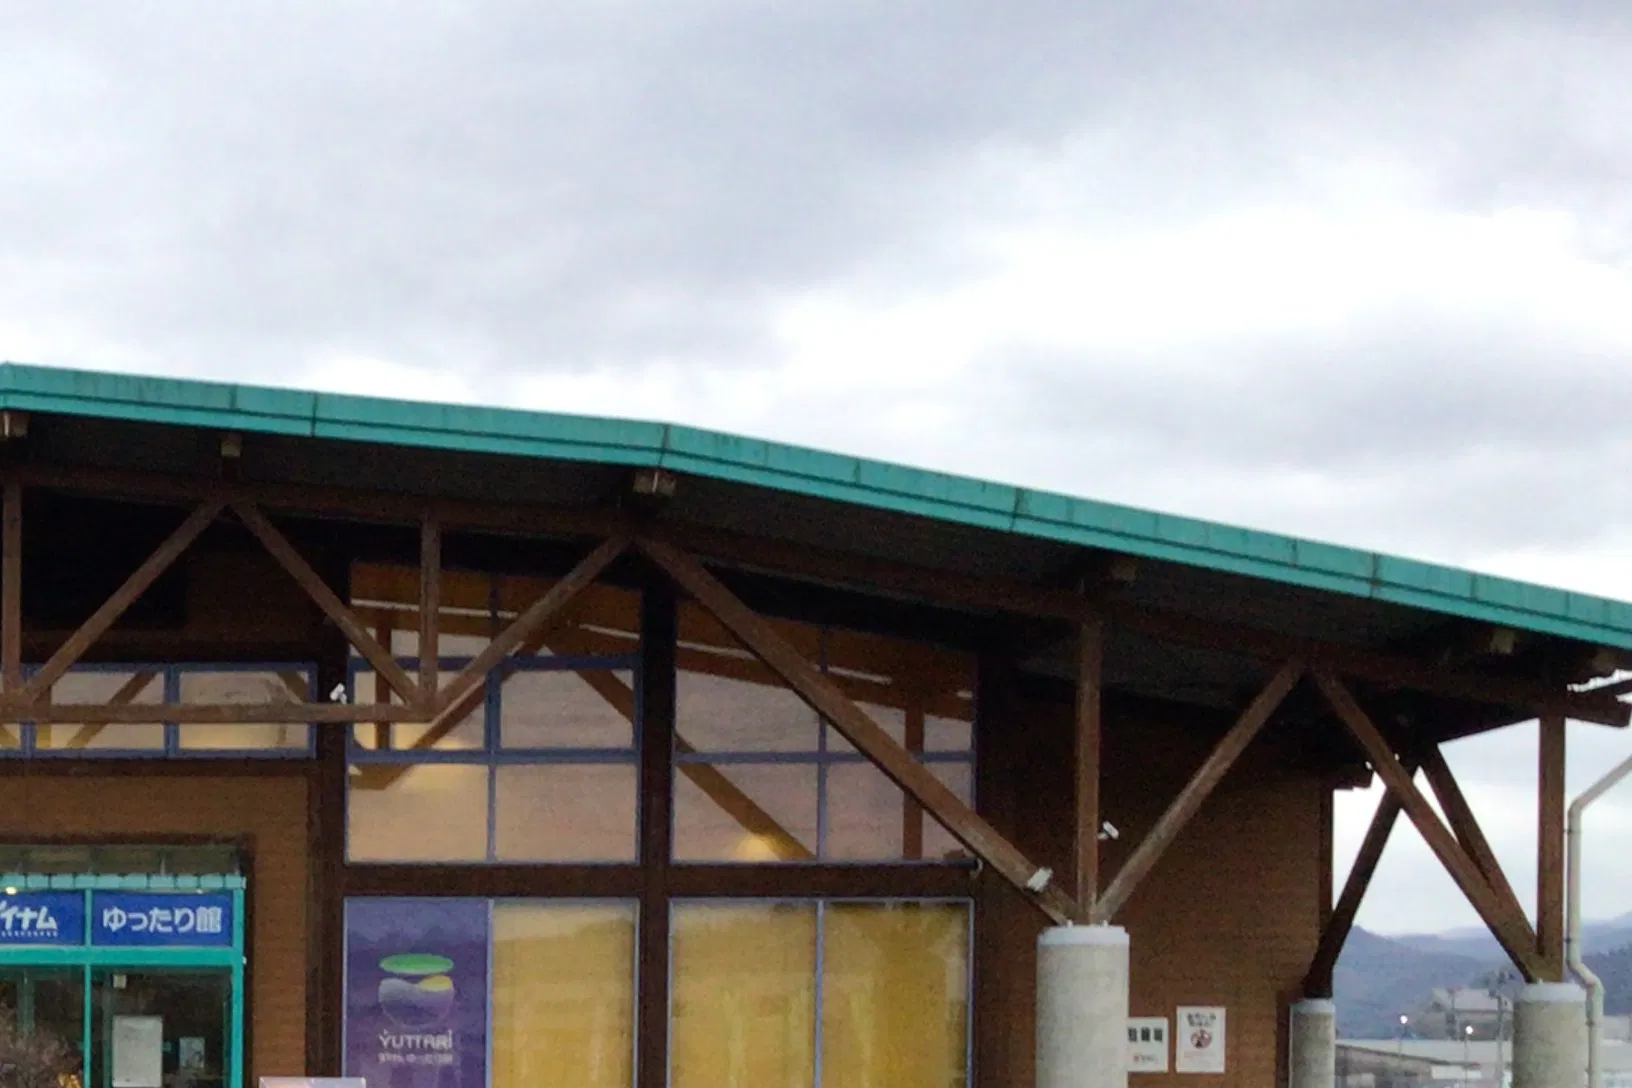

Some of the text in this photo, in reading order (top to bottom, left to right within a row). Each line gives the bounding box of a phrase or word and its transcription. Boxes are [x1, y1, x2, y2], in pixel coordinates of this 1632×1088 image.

[102, 906, 222, 934] ゆったり館
